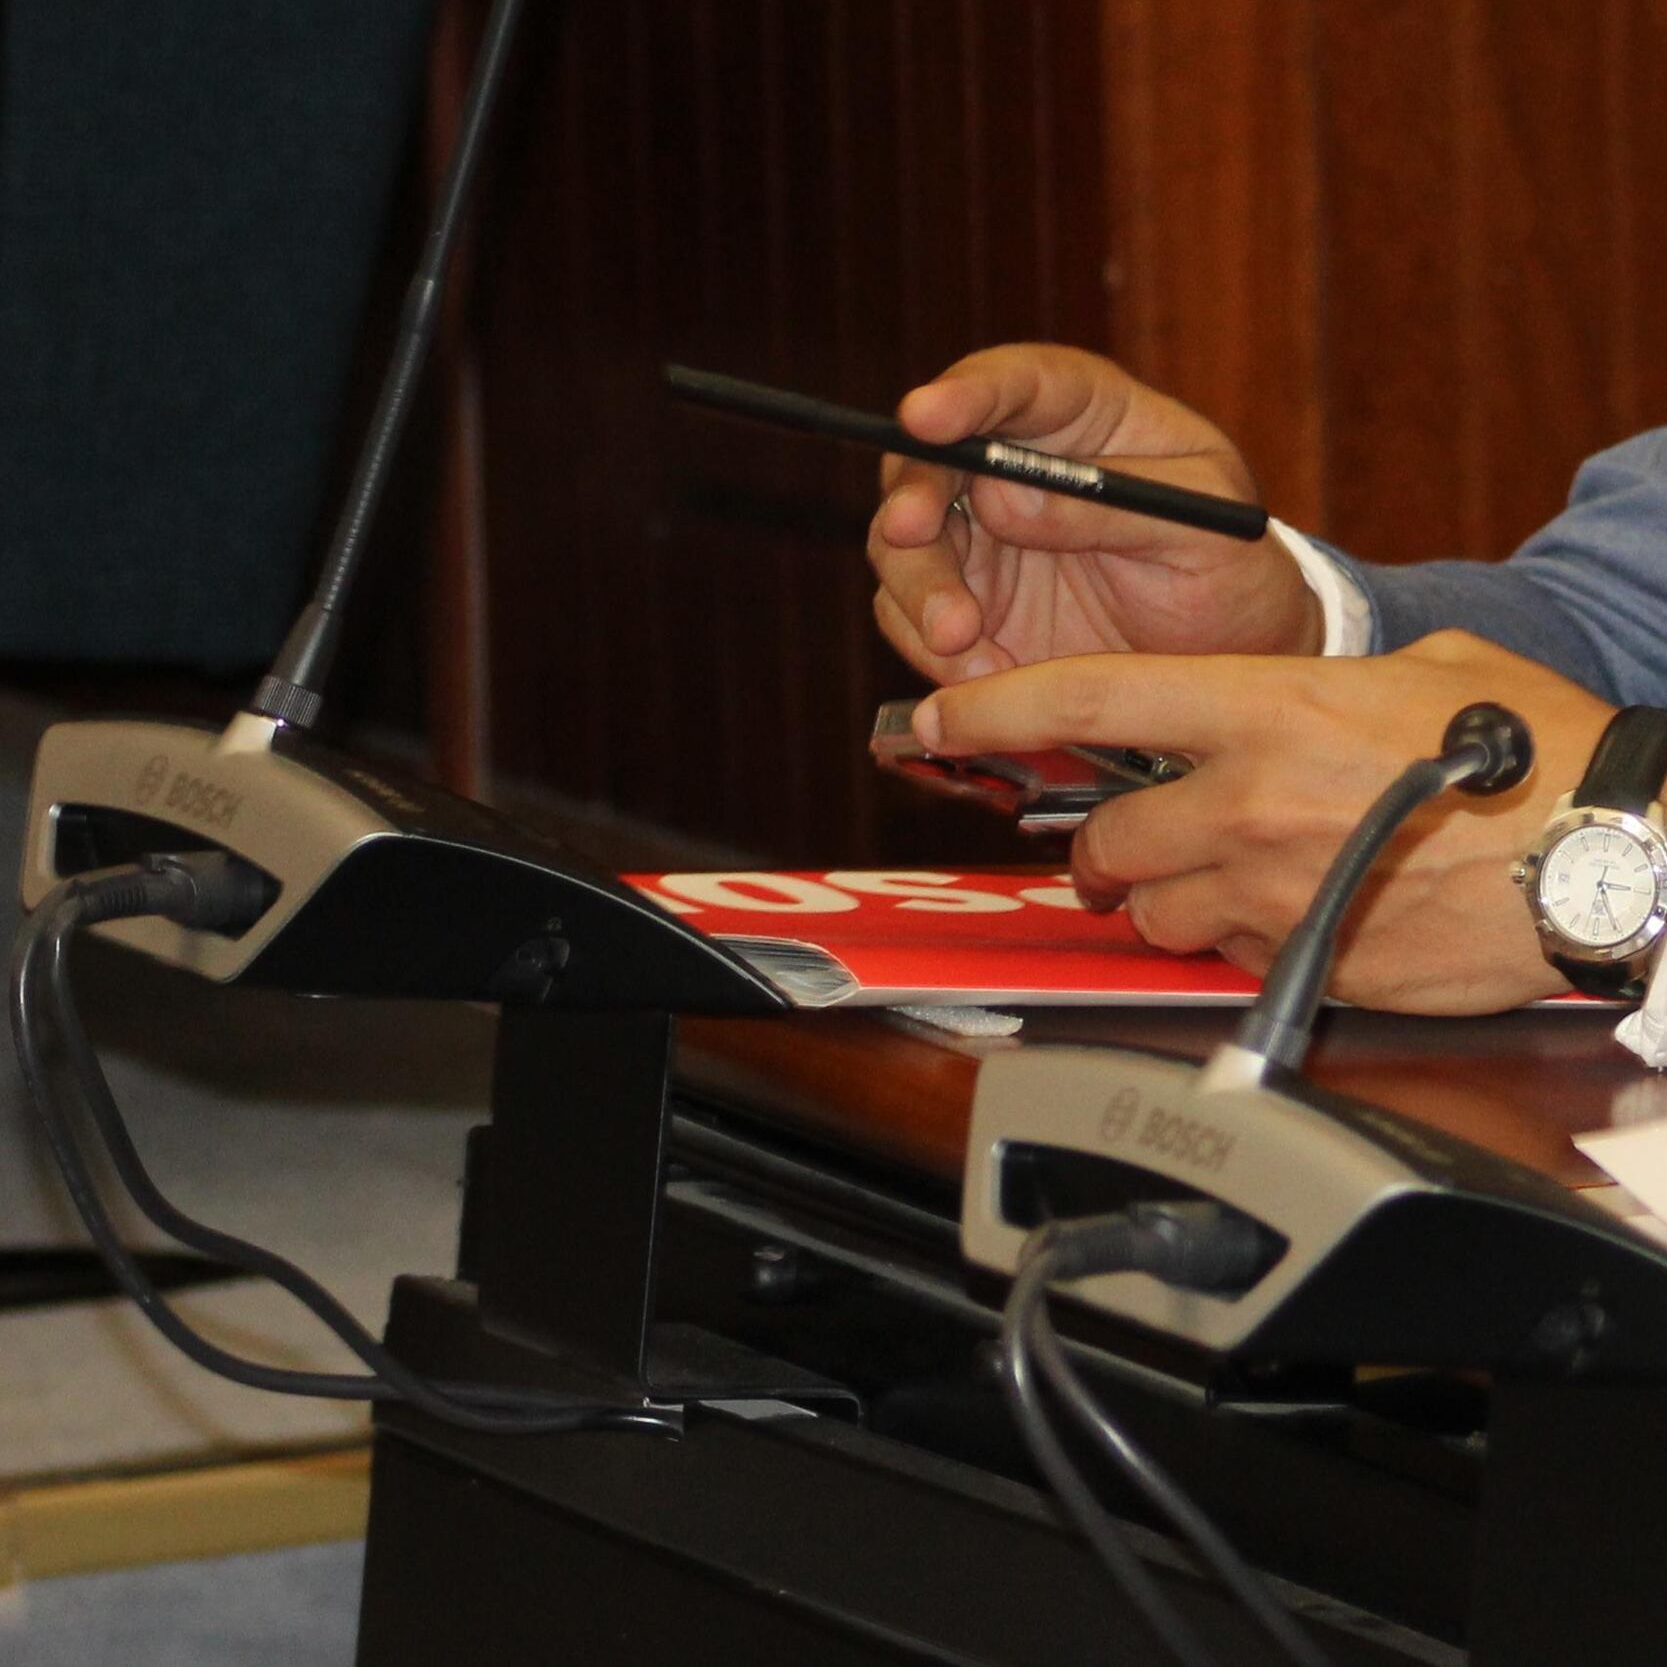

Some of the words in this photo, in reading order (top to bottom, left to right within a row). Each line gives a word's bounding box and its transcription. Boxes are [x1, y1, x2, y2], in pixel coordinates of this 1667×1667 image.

[164, 771, 243, 829] BOSCH
[637, 871, 1126, 914] SO
[1138, 1107, 1237, 1172] BOSCH
